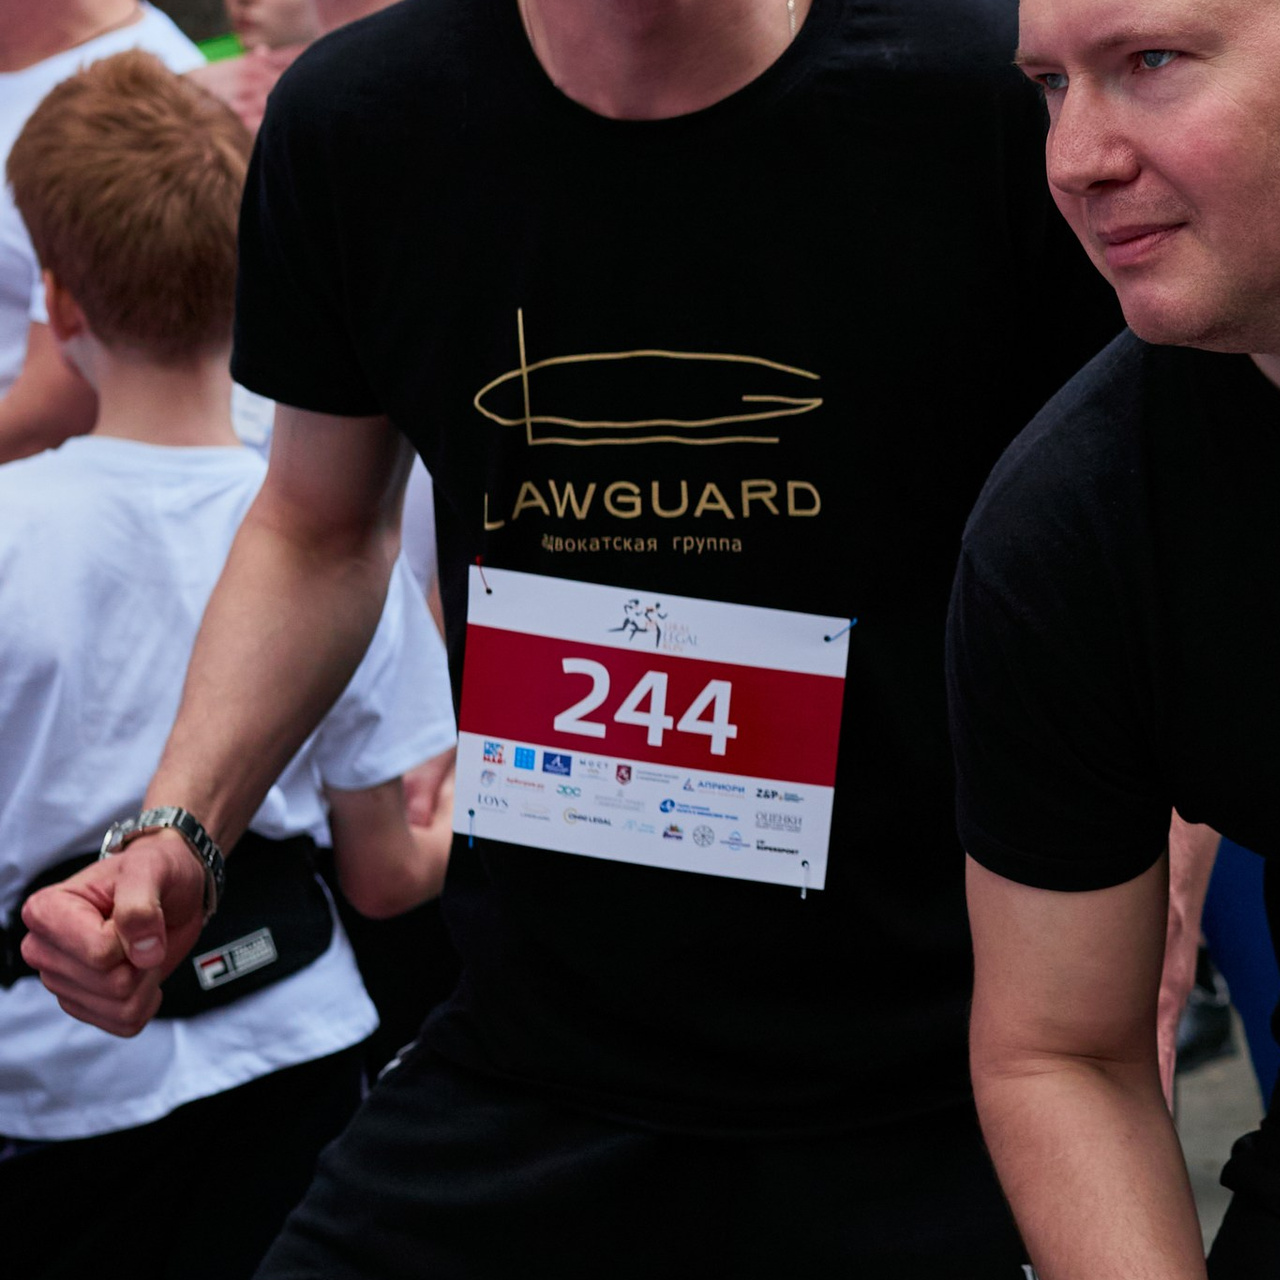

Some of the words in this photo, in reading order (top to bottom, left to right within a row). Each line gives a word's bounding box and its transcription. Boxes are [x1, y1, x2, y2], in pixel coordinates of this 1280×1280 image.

[484, 479, 822, 531] LAWGUARD
[673, 535, 743, 555] группа
[553, 657, 738, 756] 244
